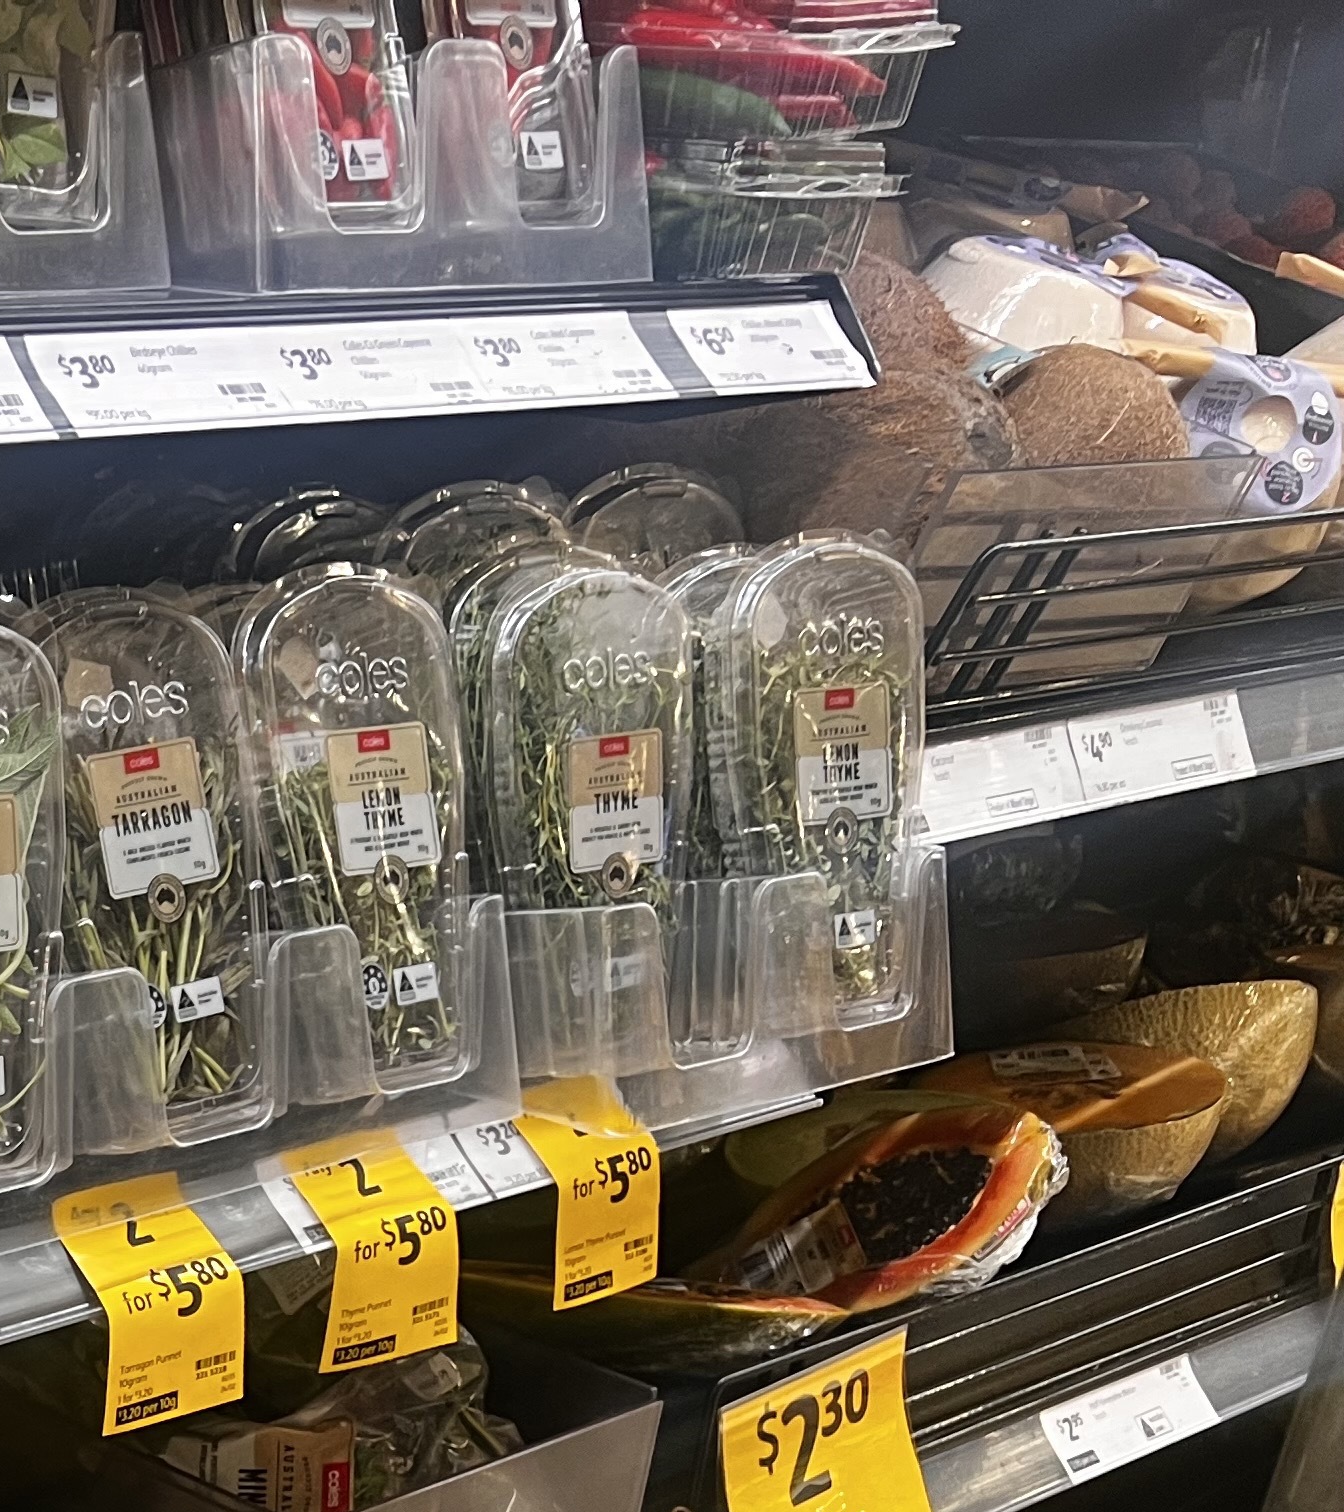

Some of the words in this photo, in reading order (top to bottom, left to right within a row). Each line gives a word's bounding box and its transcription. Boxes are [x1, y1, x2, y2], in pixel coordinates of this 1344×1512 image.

[798, 614, 884, 657] coles
[314, 647, 409, 697] coles
[562, 650, 652, 691] coles
[81, 680, 190, 728] coles
[361, 786, 403, 809] LEMON
[594, 790, 639, 814] THYME
[111, 802, 193, 838] TARRAGON
[363, 807, 404, 830] THYME
[338, 1158, 382, 1197] 2
[573, 1178, 594, 1200] for
[354, 1239, 380, 1264] for
[122, 1291, 152, 1314] for
